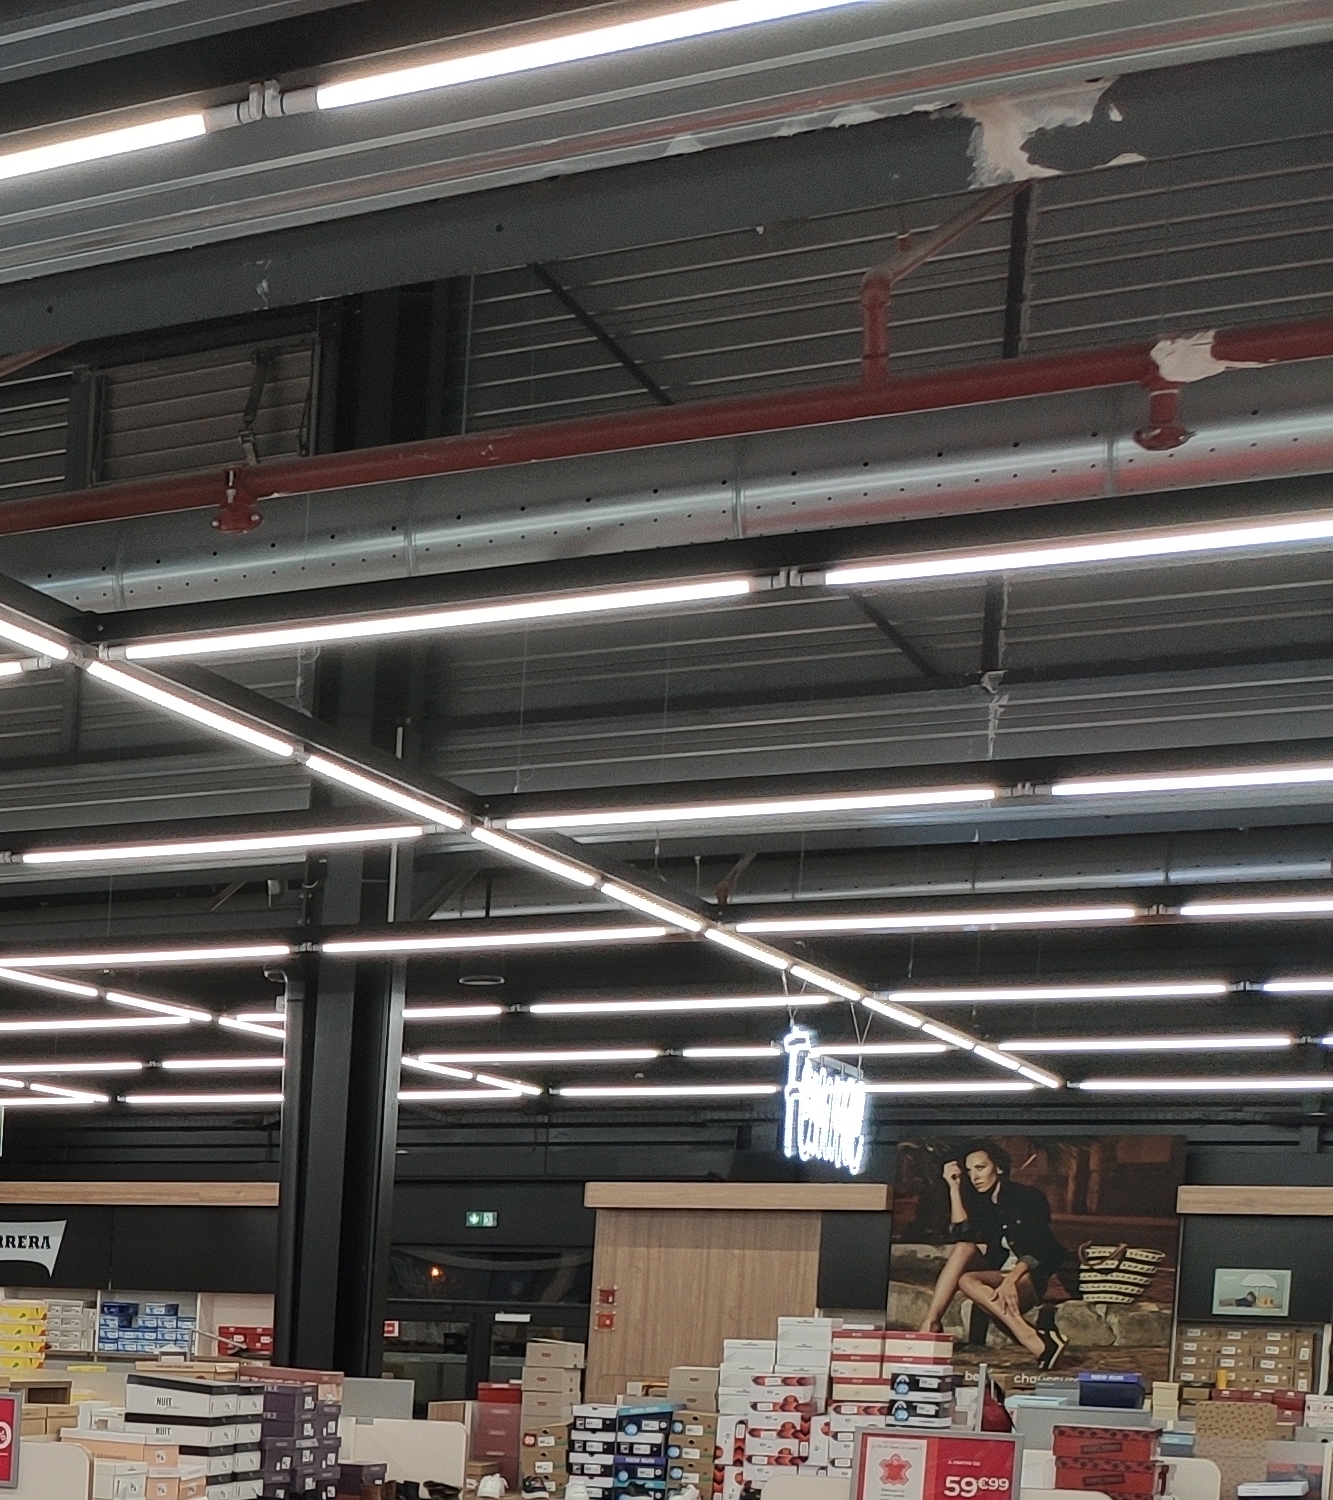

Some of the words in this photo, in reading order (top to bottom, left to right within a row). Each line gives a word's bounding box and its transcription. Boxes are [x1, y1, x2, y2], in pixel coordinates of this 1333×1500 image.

[156, 1397, 173, 1408] NUIT
[155, 1426, 172, 1437] NUIT
[944, 1475, 1009, 1498] 59€99
